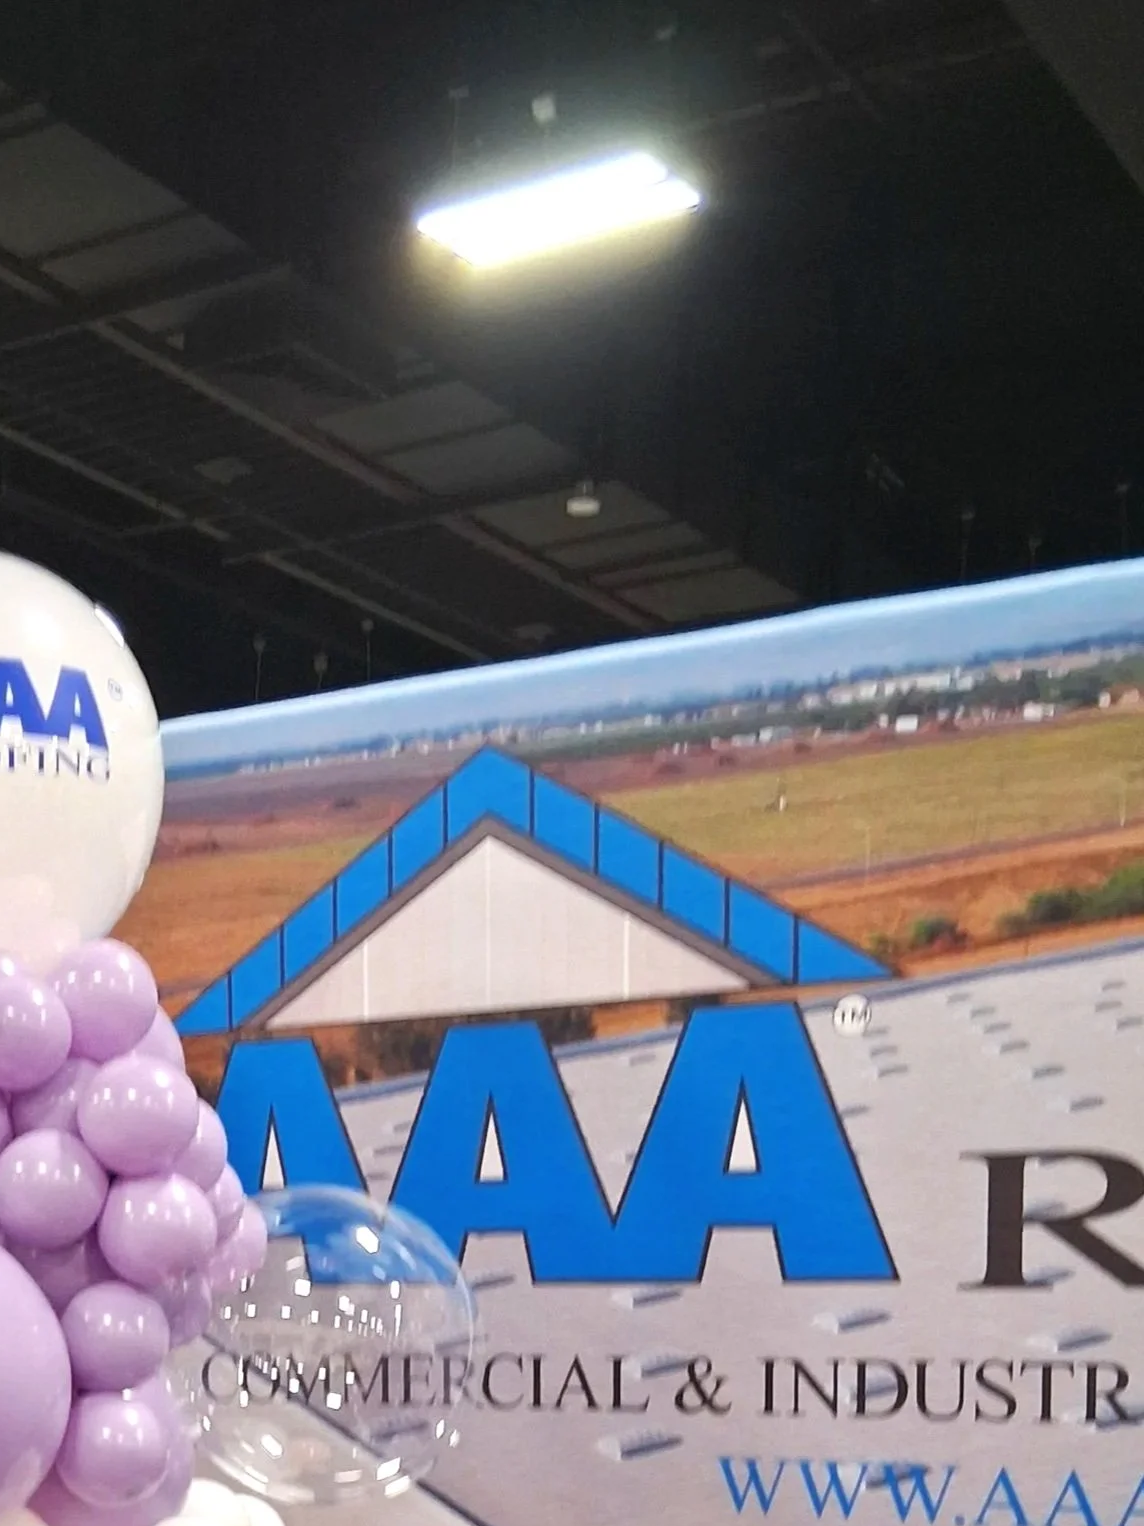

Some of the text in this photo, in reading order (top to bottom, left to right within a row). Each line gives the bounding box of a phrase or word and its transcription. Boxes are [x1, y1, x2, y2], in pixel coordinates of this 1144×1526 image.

[216, 1002, 900, 1285] AAA
[201, 1352, 650, 1414] COMMERCIAL
[673, 1354, 732, 1418] &
